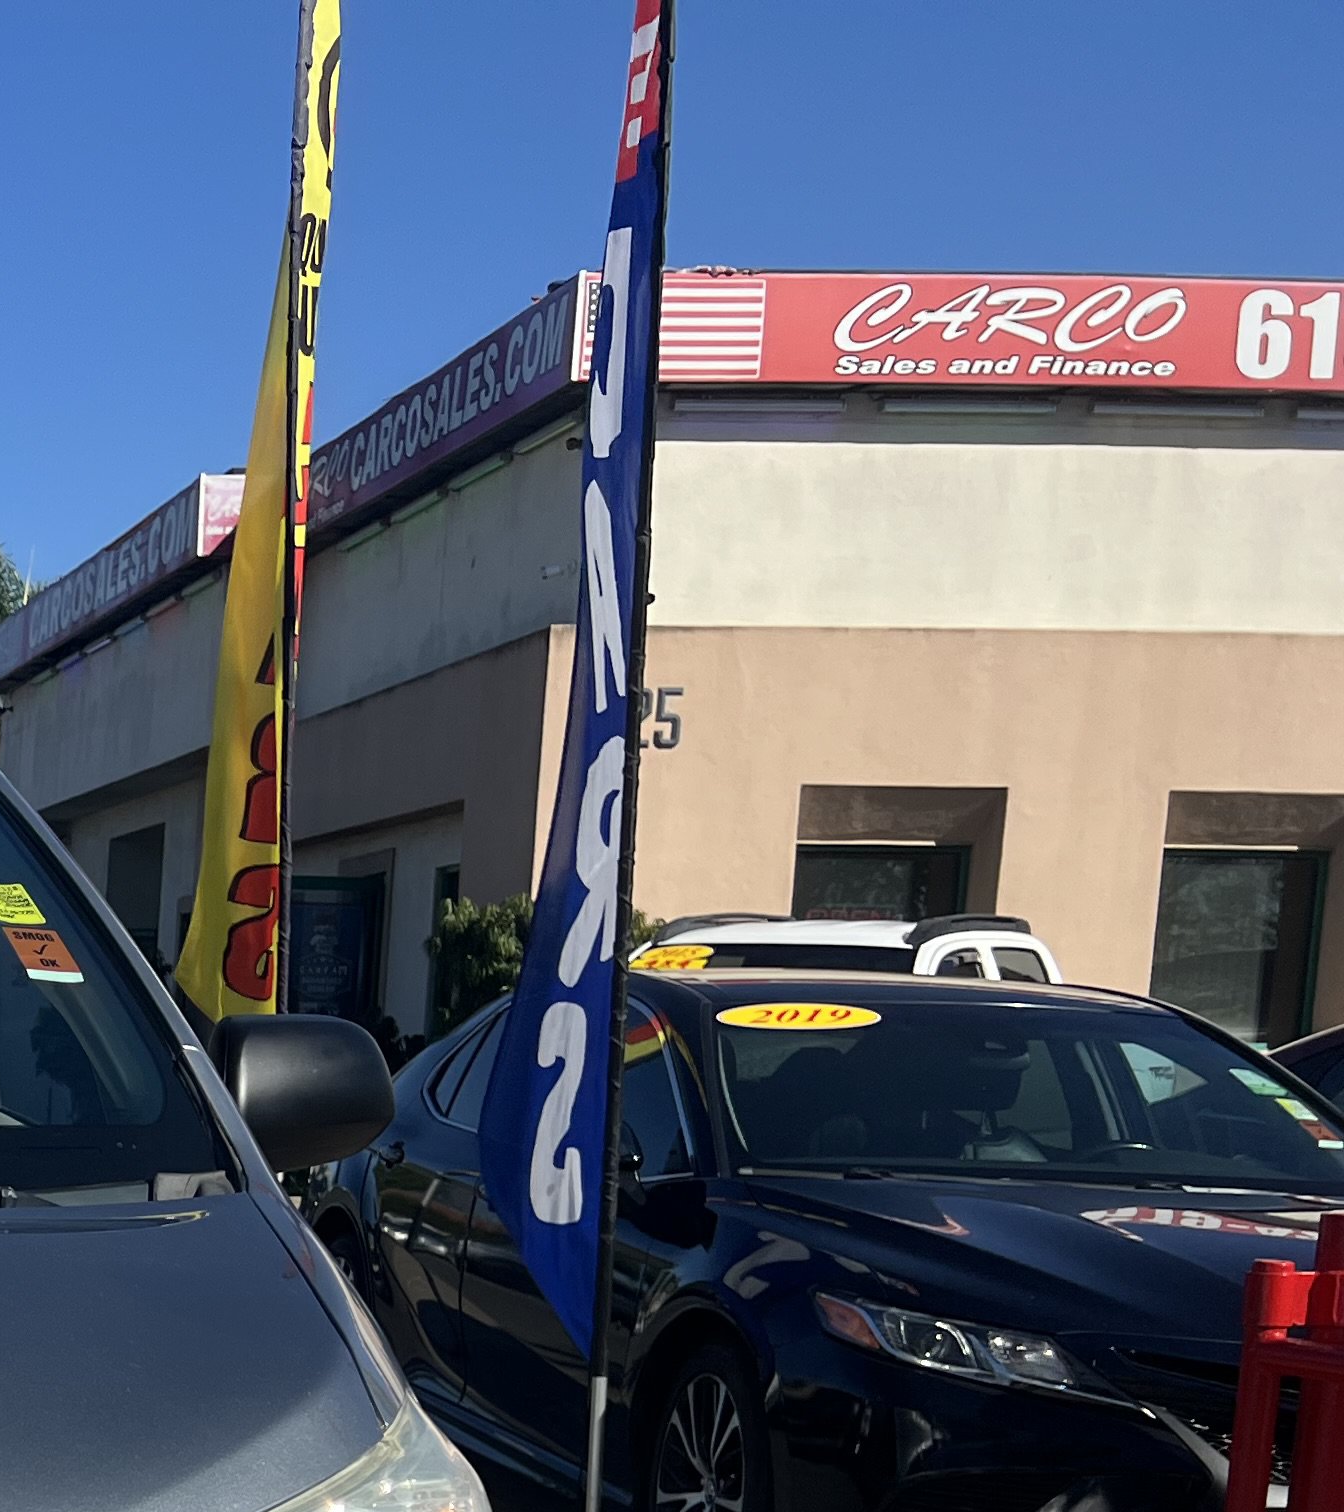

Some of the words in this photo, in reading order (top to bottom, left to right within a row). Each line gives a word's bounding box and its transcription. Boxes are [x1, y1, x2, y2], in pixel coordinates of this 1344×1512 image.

[834, 283, 1187, 352] CARCO
[835, 355, 935, 376] Sales
[951, 355, 1021, 376] and
[1028, 355, 1175, 378] Finance
[350, 293, 569, 492] CARCOSALES.COM
[28, 489, 197, 649] CARCOSALES.COM
[12, 930, 55, 942] SMOG
[40, 958, 60, 968] OK
[750, 1007, 852, 1024] 2019
